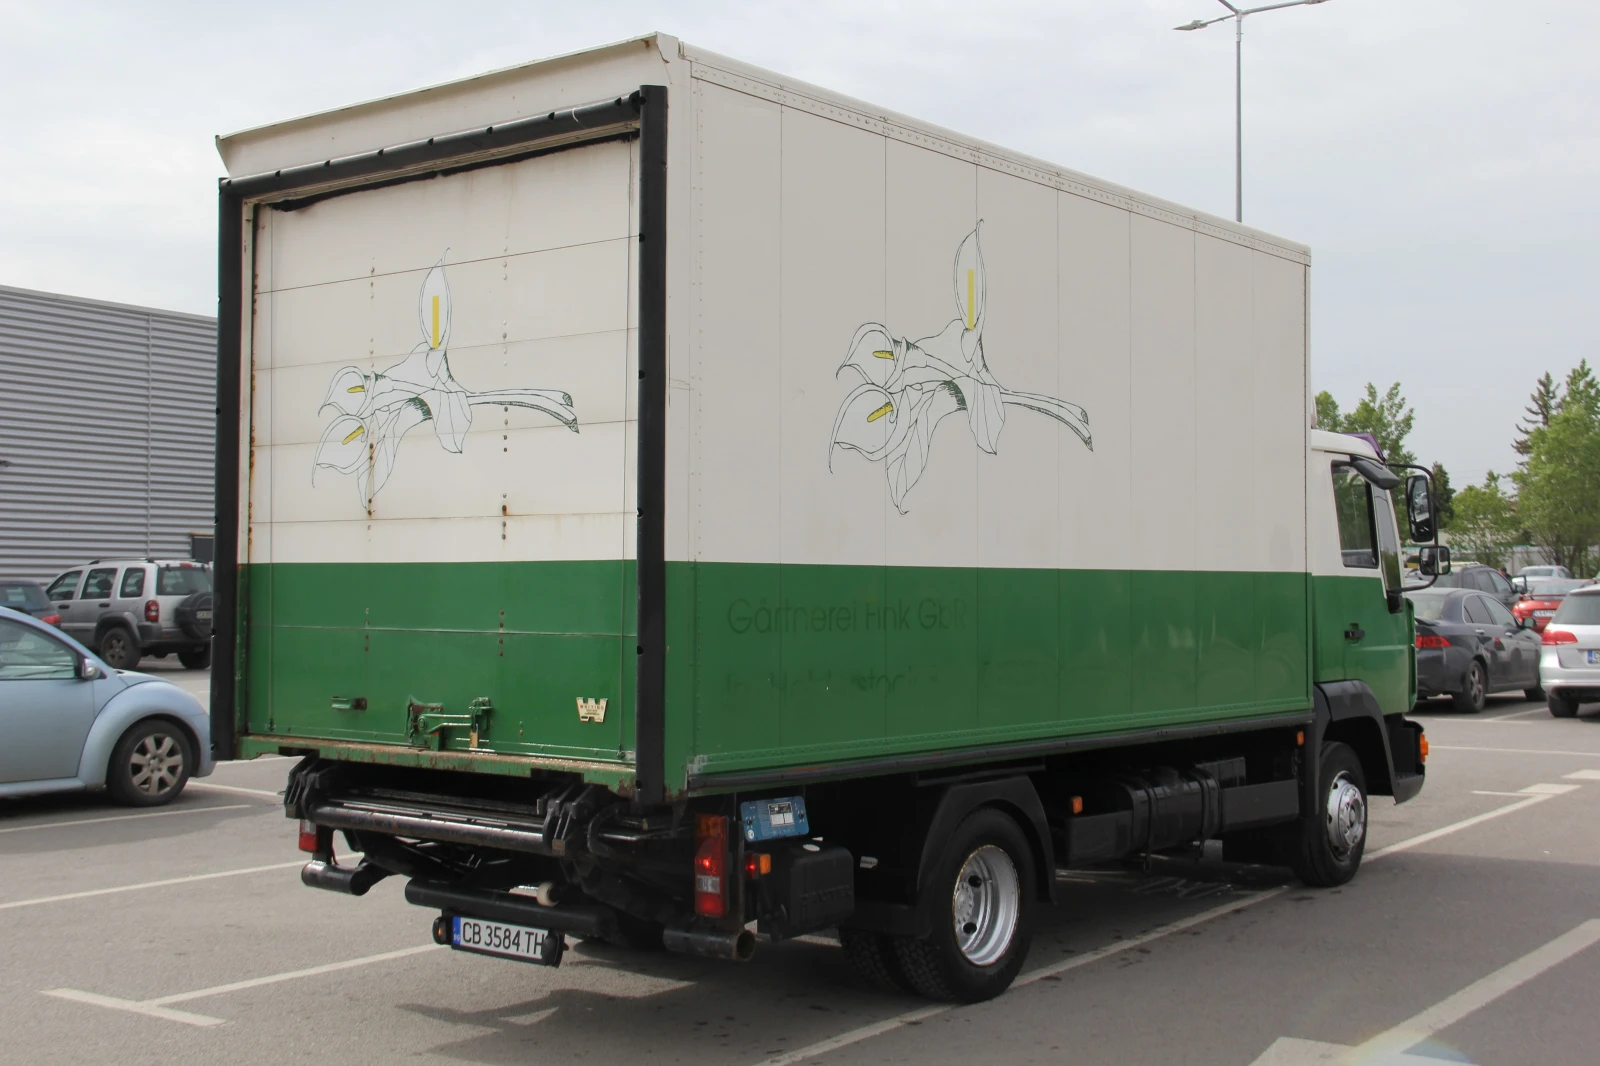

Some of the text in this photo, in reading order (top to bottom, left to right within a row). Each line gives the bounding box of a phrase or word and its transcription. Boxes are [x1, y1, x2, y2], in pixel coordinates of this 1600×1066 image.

[727, 597, 857, 634] Gärtnerei
[463, 922, 544, 955] CB 3584 TH
